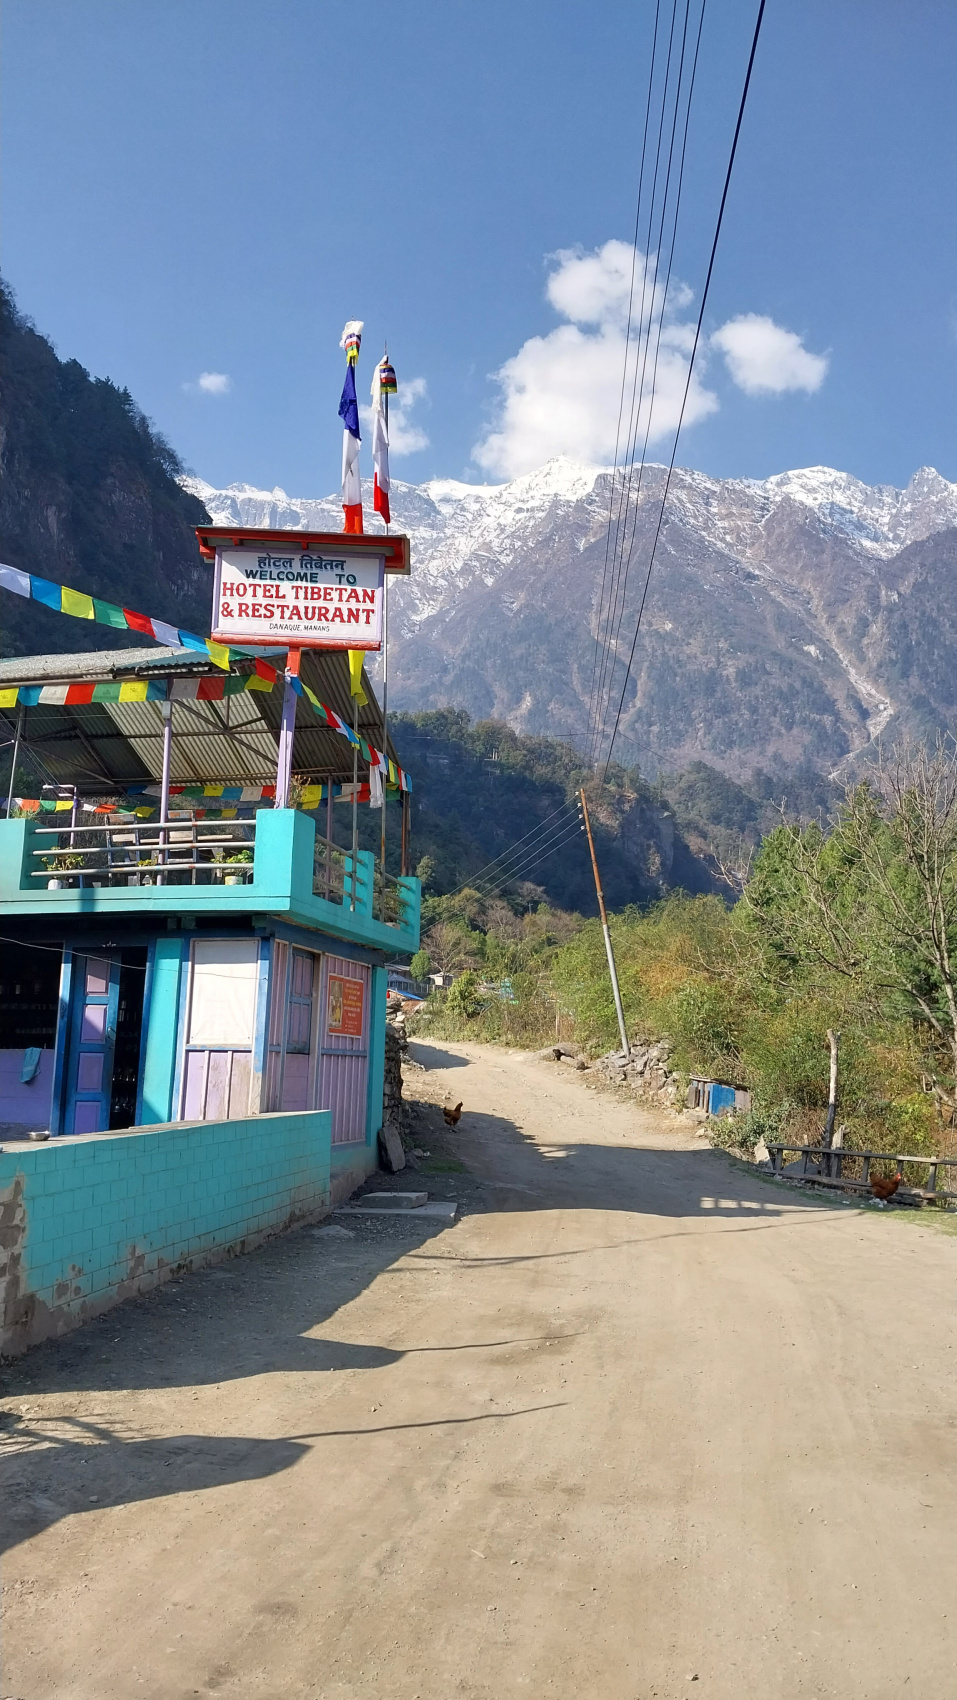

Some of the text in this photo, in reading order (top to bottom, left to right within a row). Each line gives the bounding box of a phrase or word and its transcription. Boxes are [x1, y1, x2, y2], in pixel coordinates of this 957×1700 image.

[258, 553, 346, 572] होटल तिबेतन
[245, 569, 357, 585] WELCOME TO
[222, 582, 375, 604] HOTEL TIBETAN
[221, 602, 374, 624] & RESTAURANT
[269, 623, 302, 631] DANAQUE,
